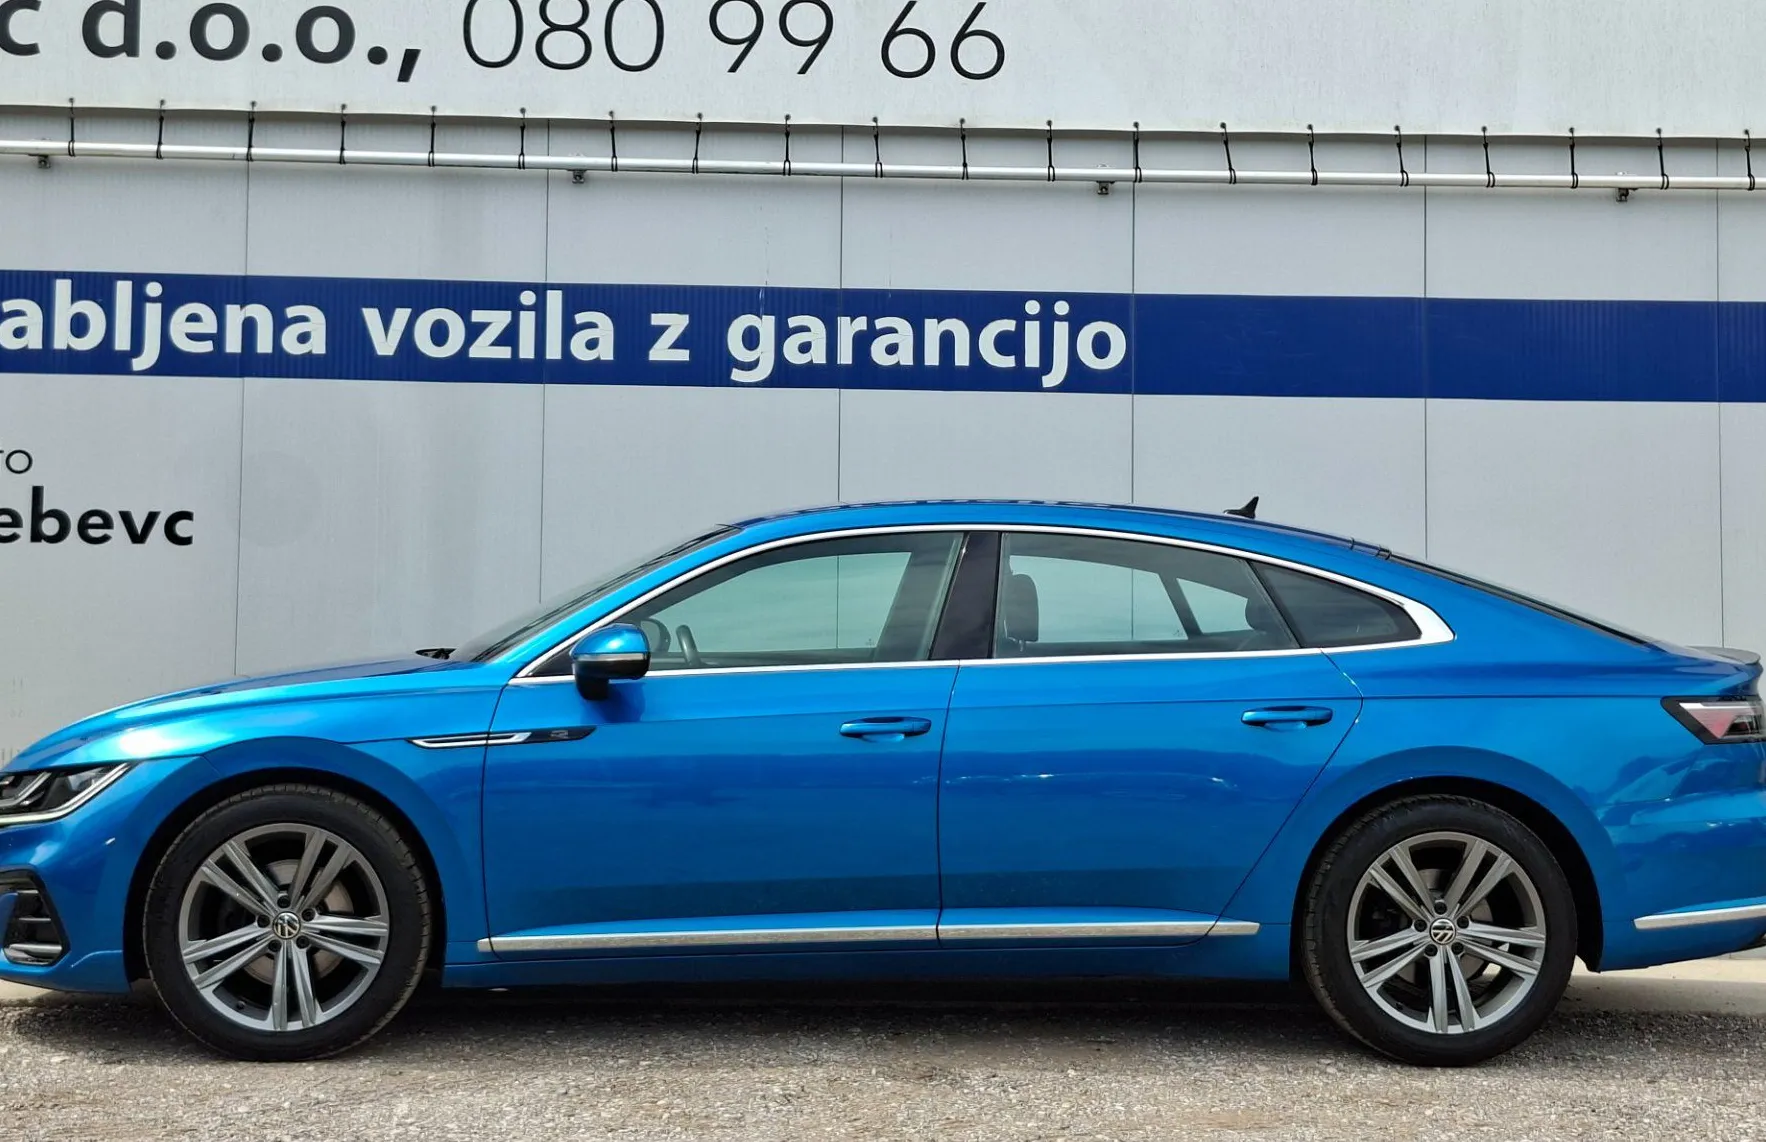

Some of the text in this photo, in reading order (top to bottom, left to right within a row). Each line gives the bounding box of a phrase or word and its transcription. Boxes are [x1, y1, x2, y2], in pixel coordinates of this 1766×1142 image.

[82, 0, 421, 83] d.o.o.,
[463, 0, 665, 72] 080
[708, 0, 834, 75] 99
[880, 0, 1005, 80] 66
[0, 279, 1127, 388] abljena vozila z garancijo
[0, 485, 194, 546] ebevc
